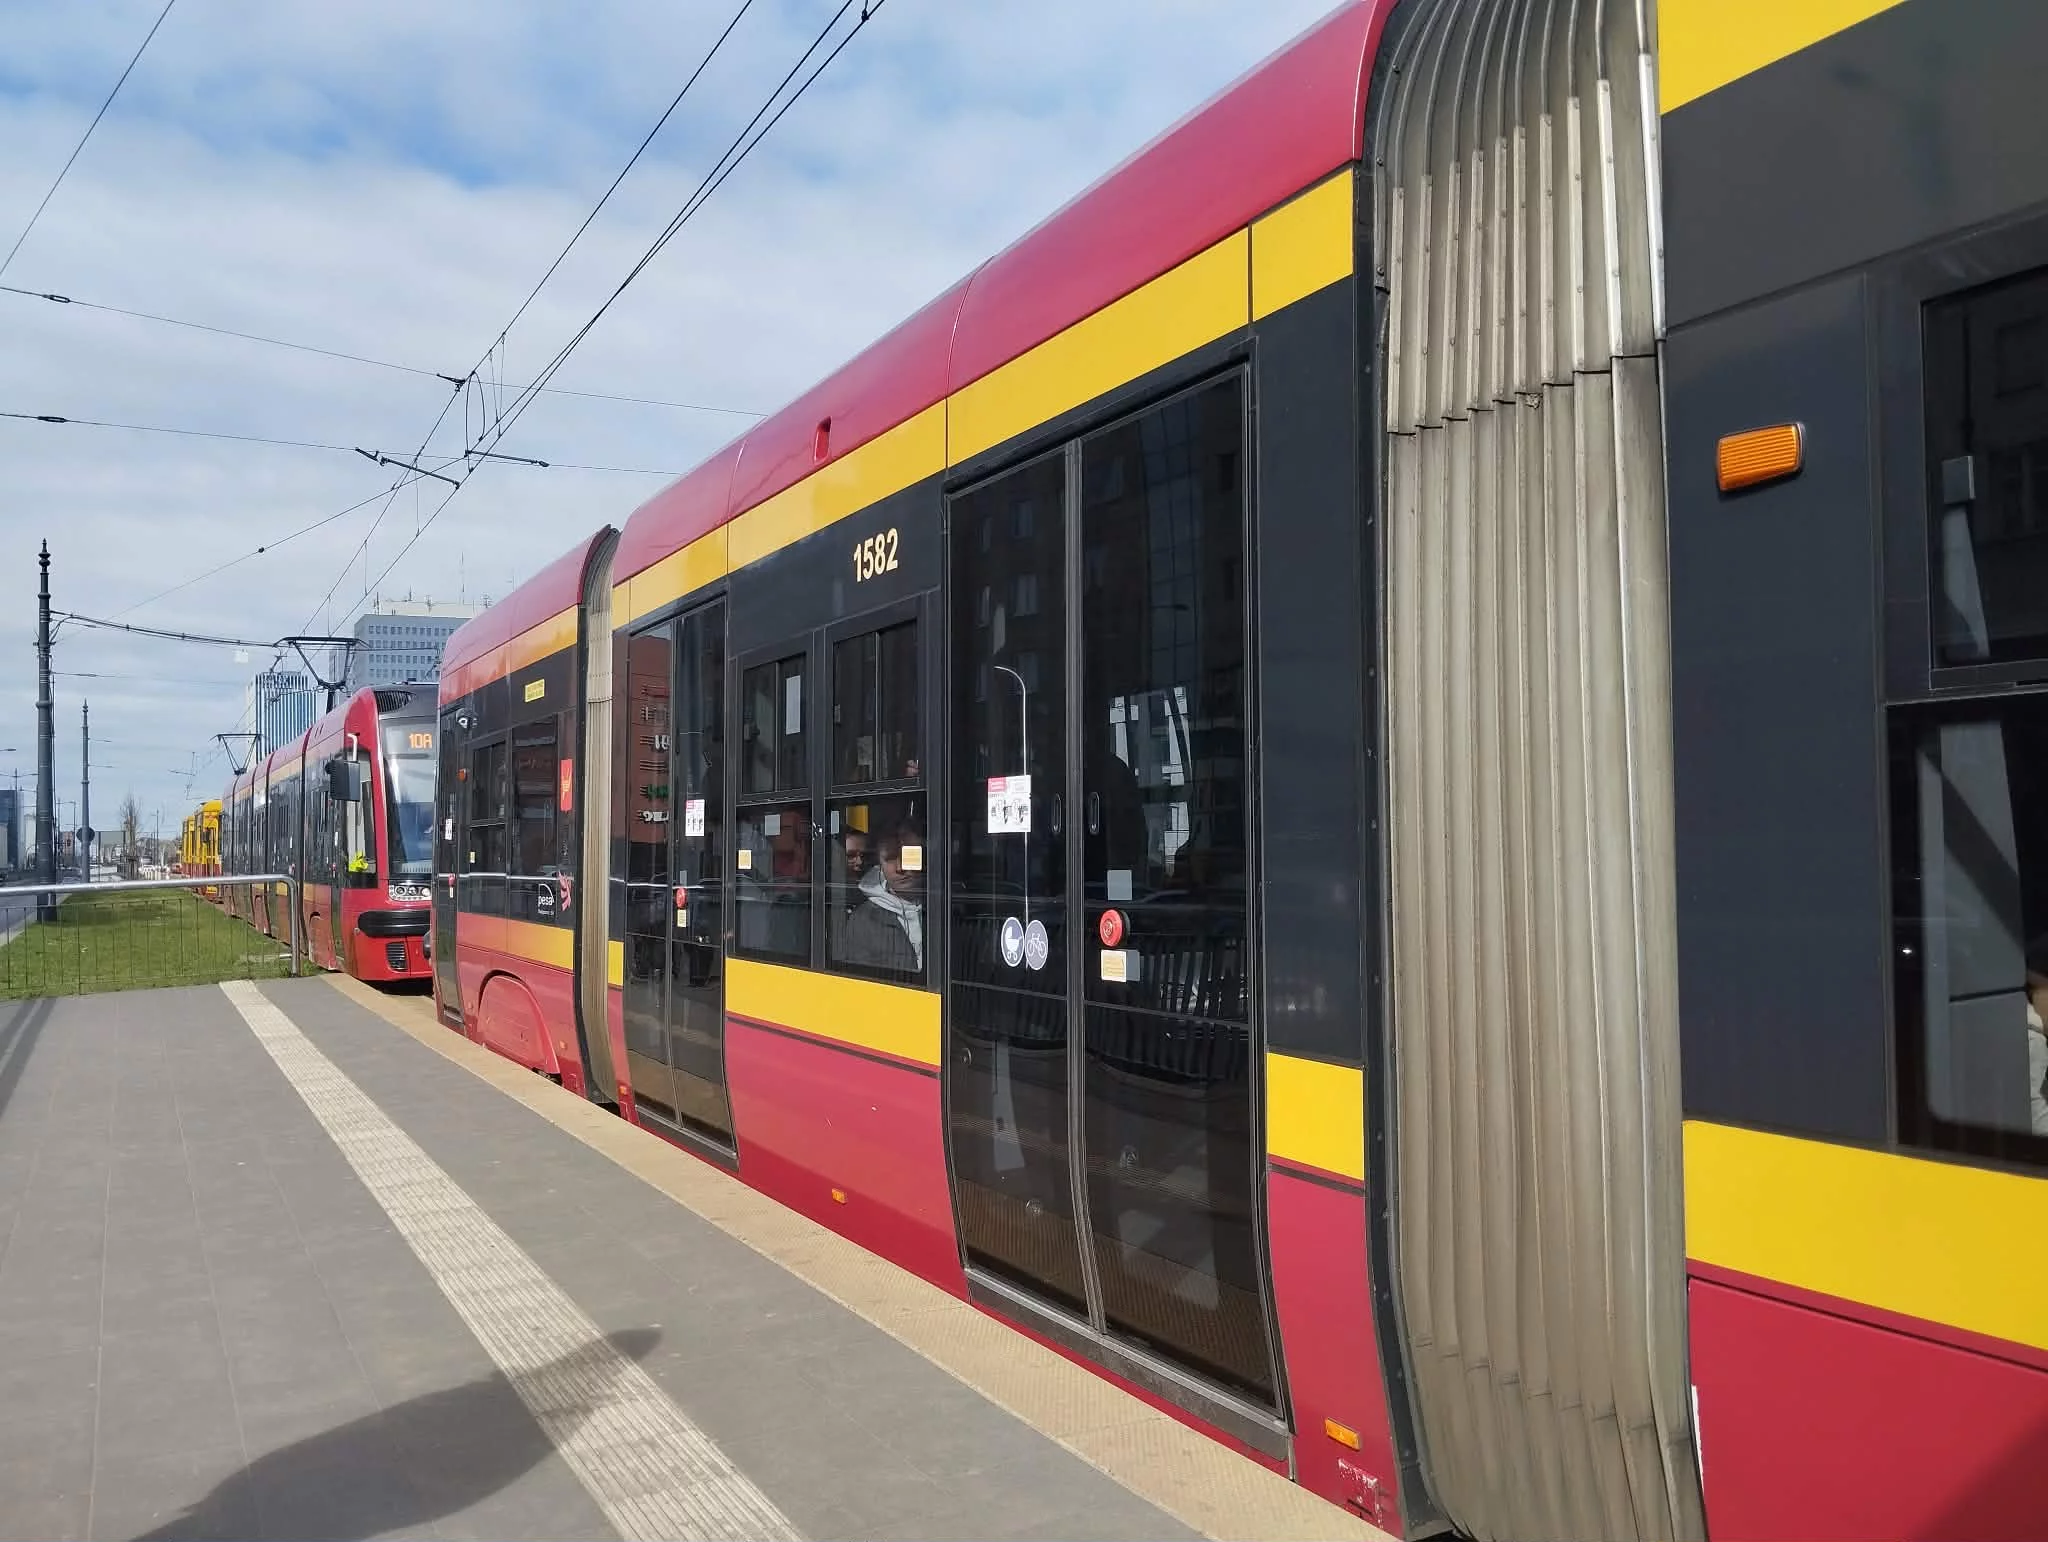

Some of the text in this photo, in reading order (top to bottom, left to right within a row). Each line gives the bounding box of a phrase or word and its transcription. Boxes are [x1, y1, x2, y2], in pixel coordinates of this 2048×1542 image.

[854, 528, 898, 582] 1582
[409, 733, 432, 749] 10A
[538, 895, 554, 907] pesa
